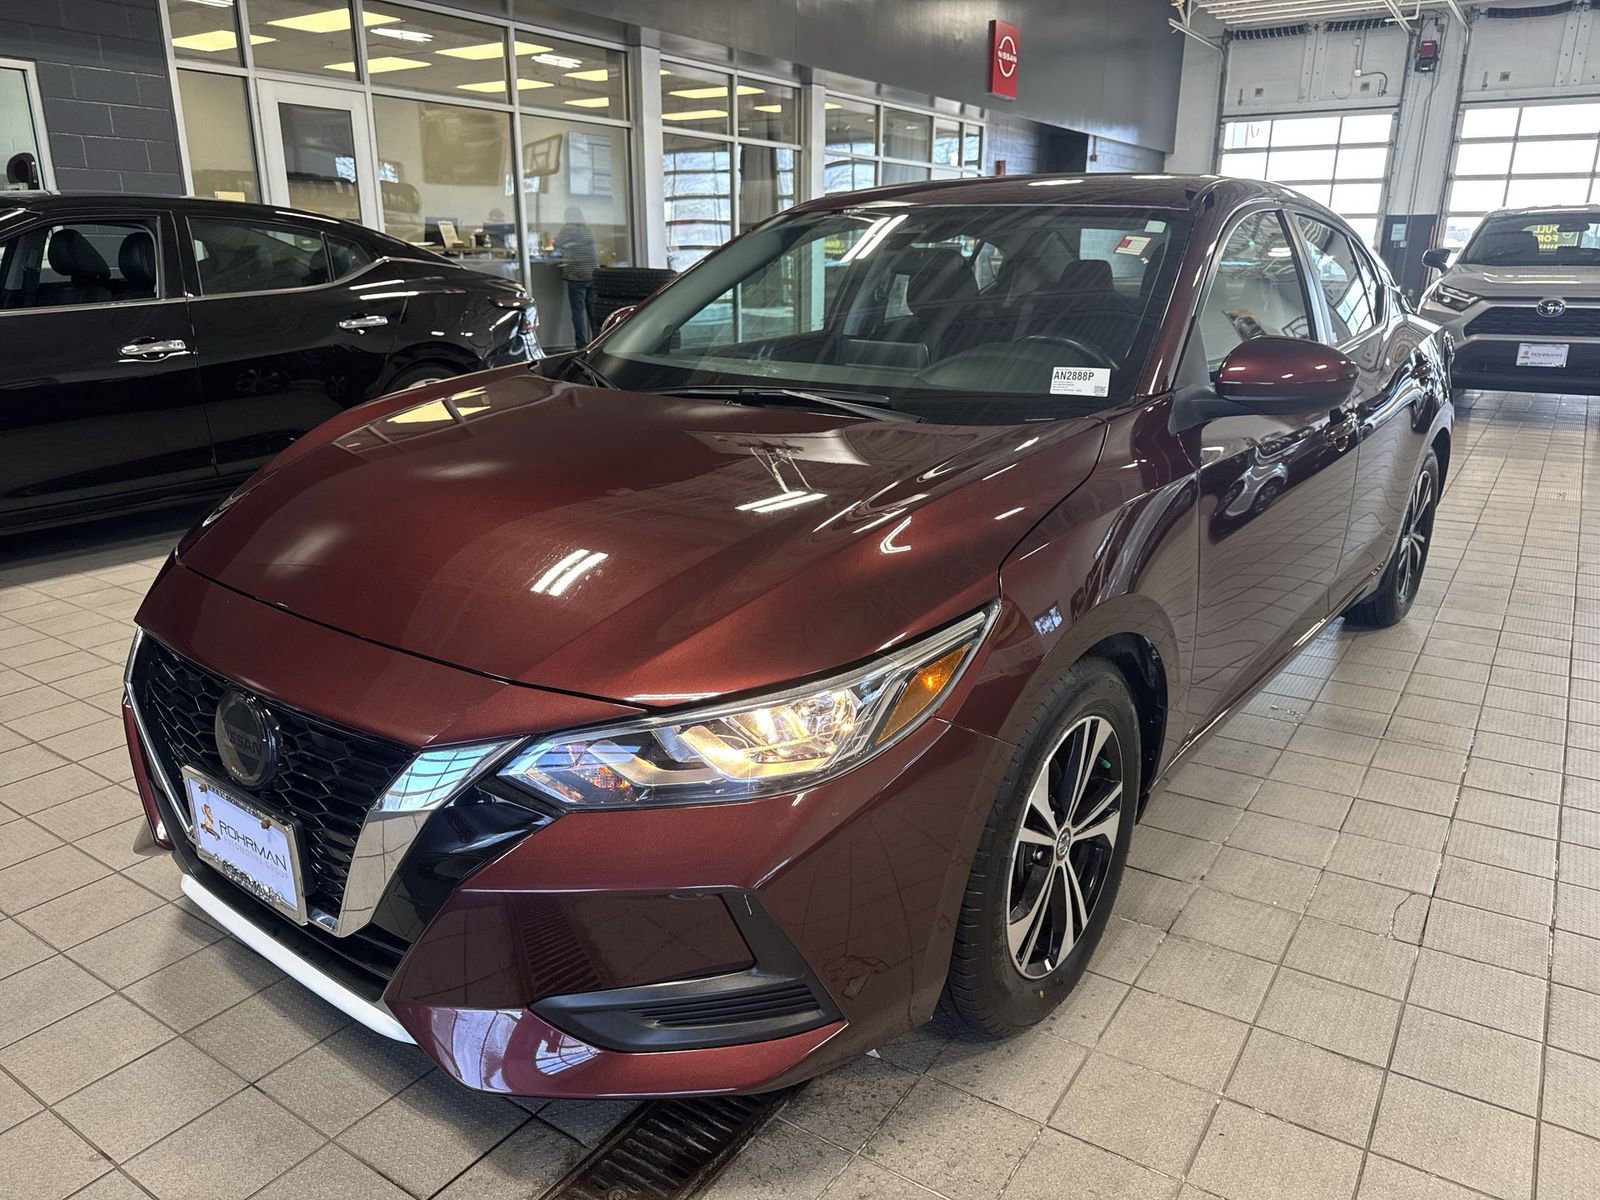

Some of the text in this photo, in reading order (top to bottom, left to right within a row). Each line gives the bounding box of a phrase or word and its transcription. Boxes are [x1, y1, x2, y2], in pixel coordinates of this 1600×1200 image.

[998, 50, 1017, 63] NISSAN
[1053, 370, 1095, 381] AN2888P
[219, 820, 287, 871] ROHRMAN
